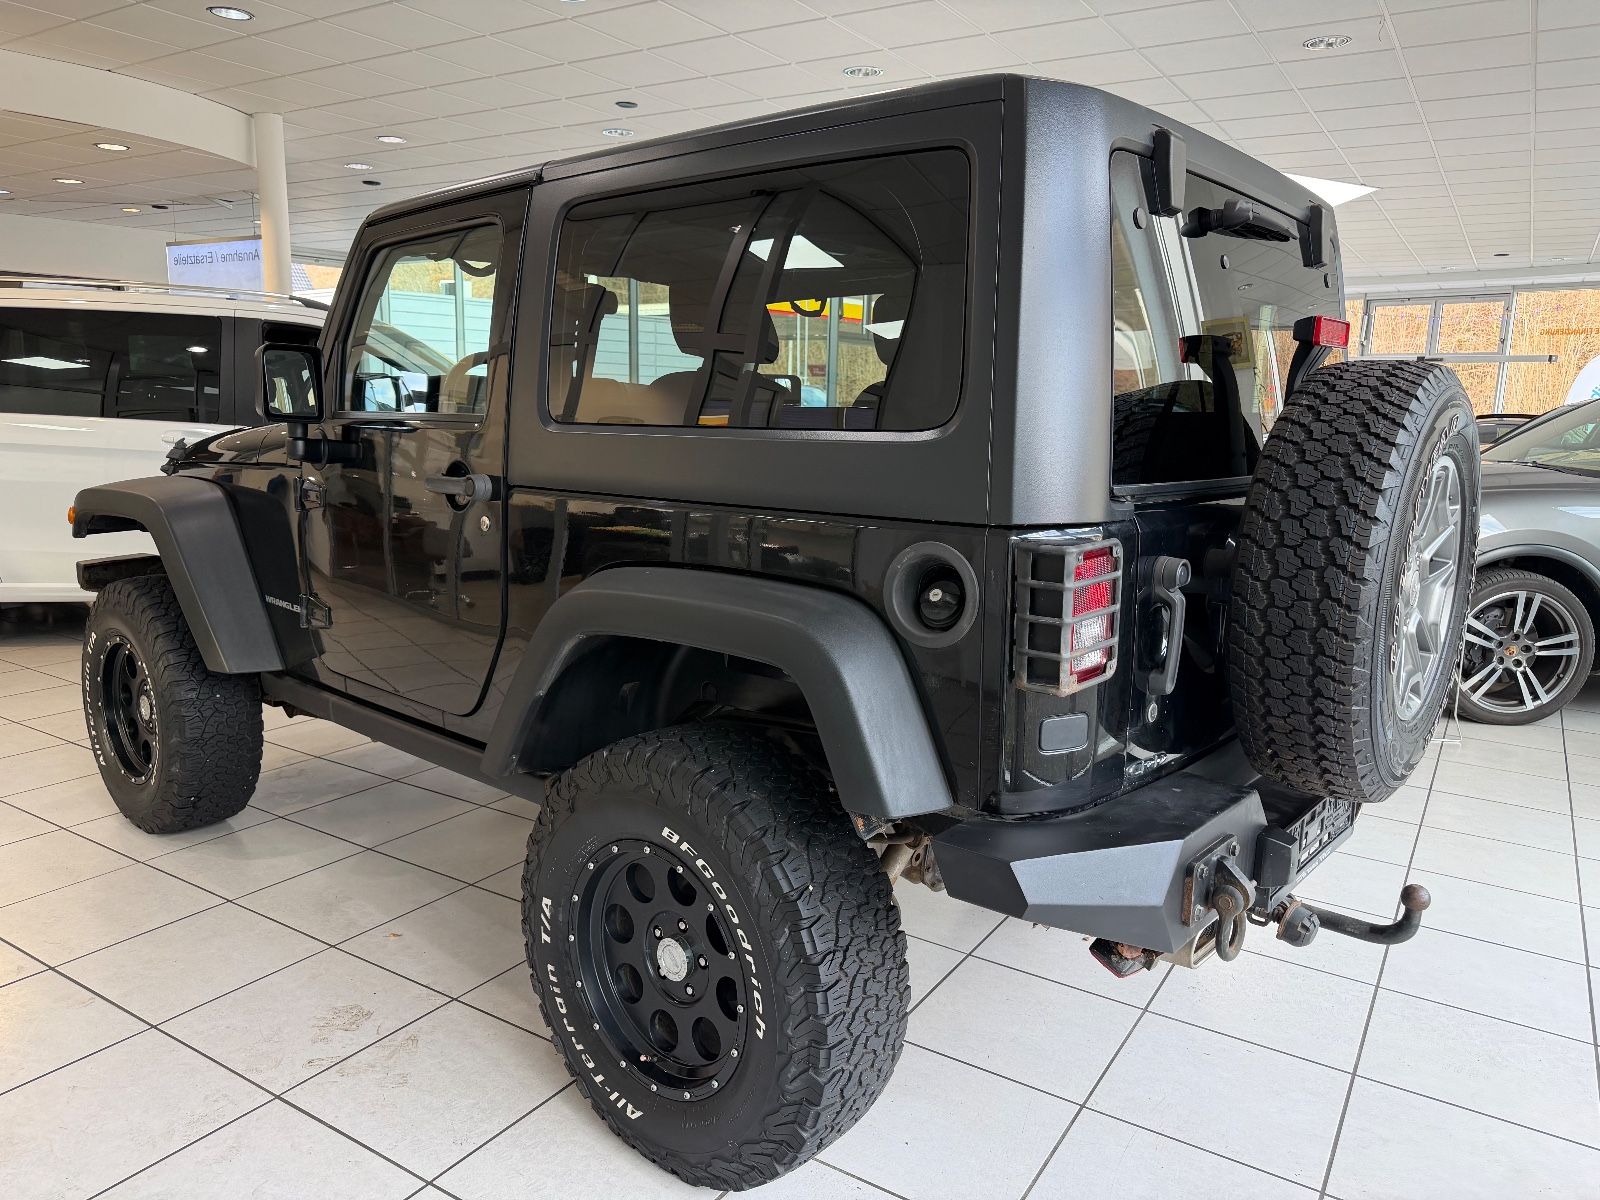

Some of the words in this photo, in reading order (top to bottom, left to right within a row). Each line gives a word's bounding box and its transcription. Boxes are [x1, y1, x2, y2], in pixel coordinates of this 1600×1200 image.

[540, 896, 552, 944] T/A
[661, 826, 766, 1040] BFGoodrich
[547, 963, 644, 1121] All-Terrain
